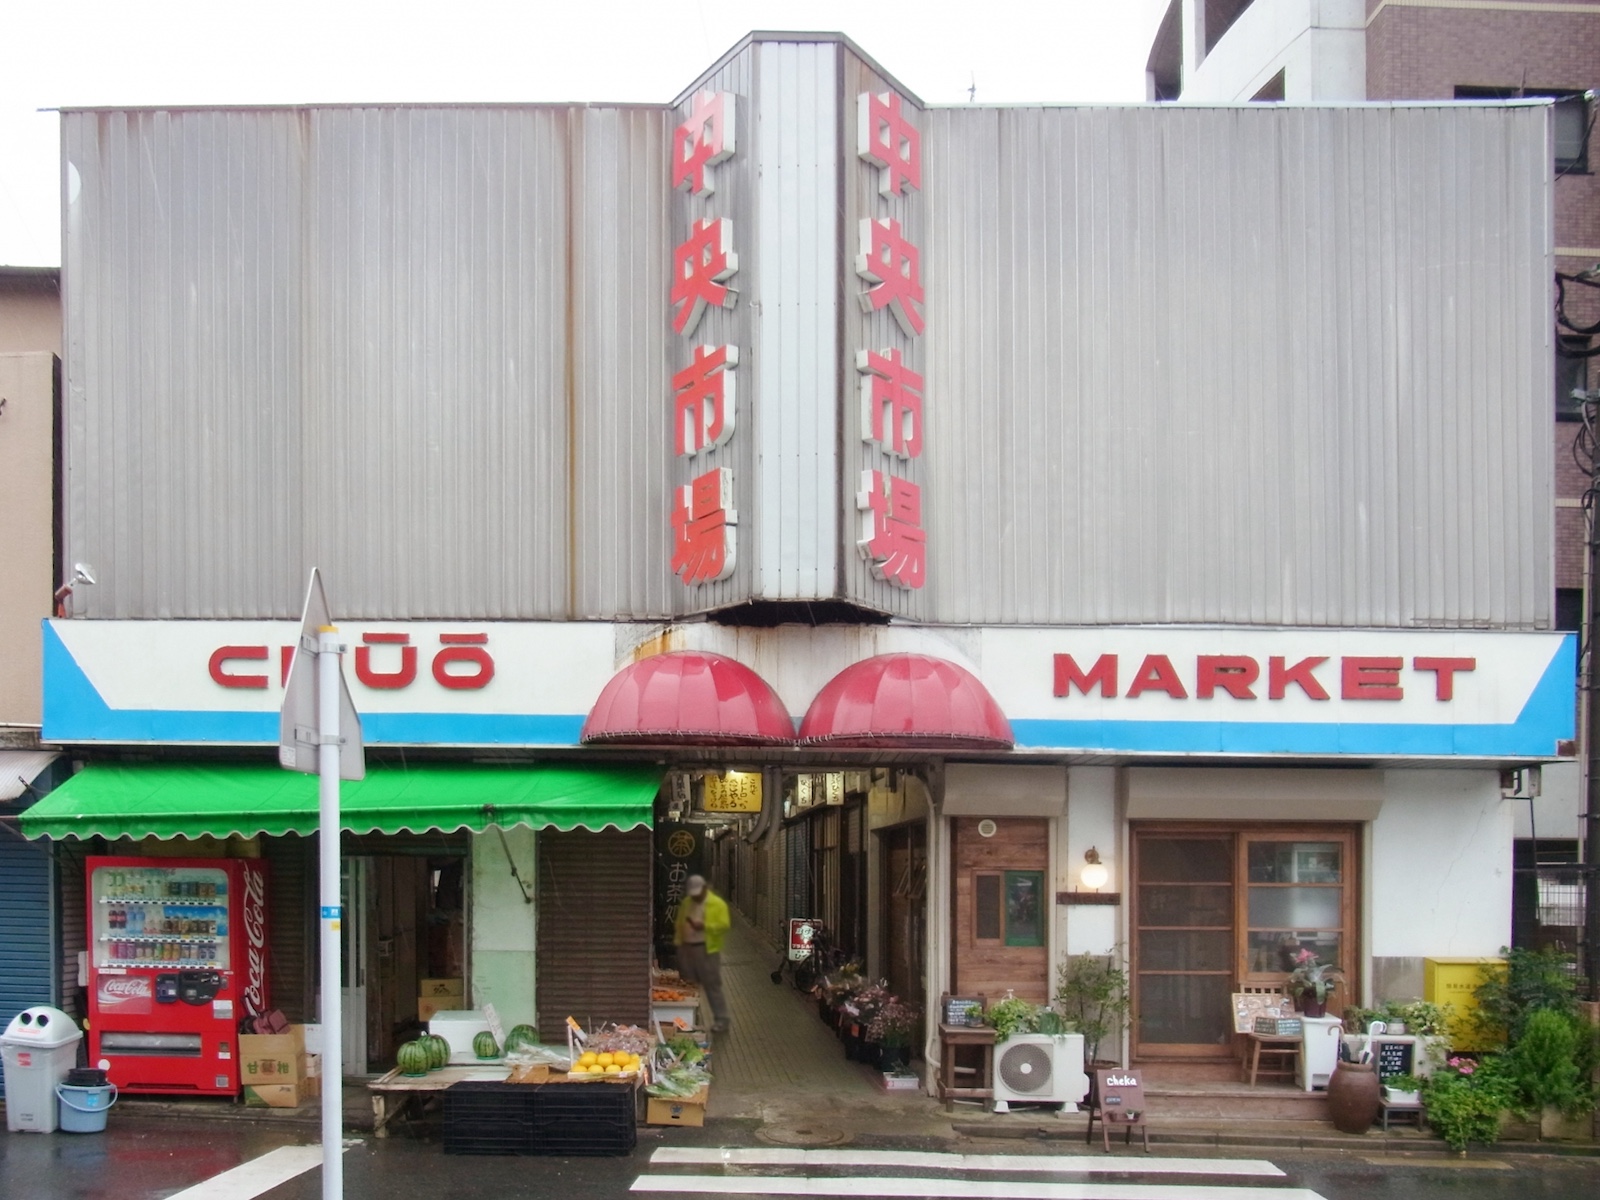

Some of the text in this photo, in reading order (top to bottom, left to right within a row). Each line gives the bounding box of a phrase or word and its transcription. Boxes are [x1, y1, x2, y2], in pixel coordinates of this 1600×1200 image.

[671, 91, 737, 587] 中央市場
[856, 91, 927, 590] 中央市場
[208, 633, 495, 689] CŪŌ
[1053, 653, 1476, 701] MARKET
[1106, 1074, 1137, 1087] cheka
